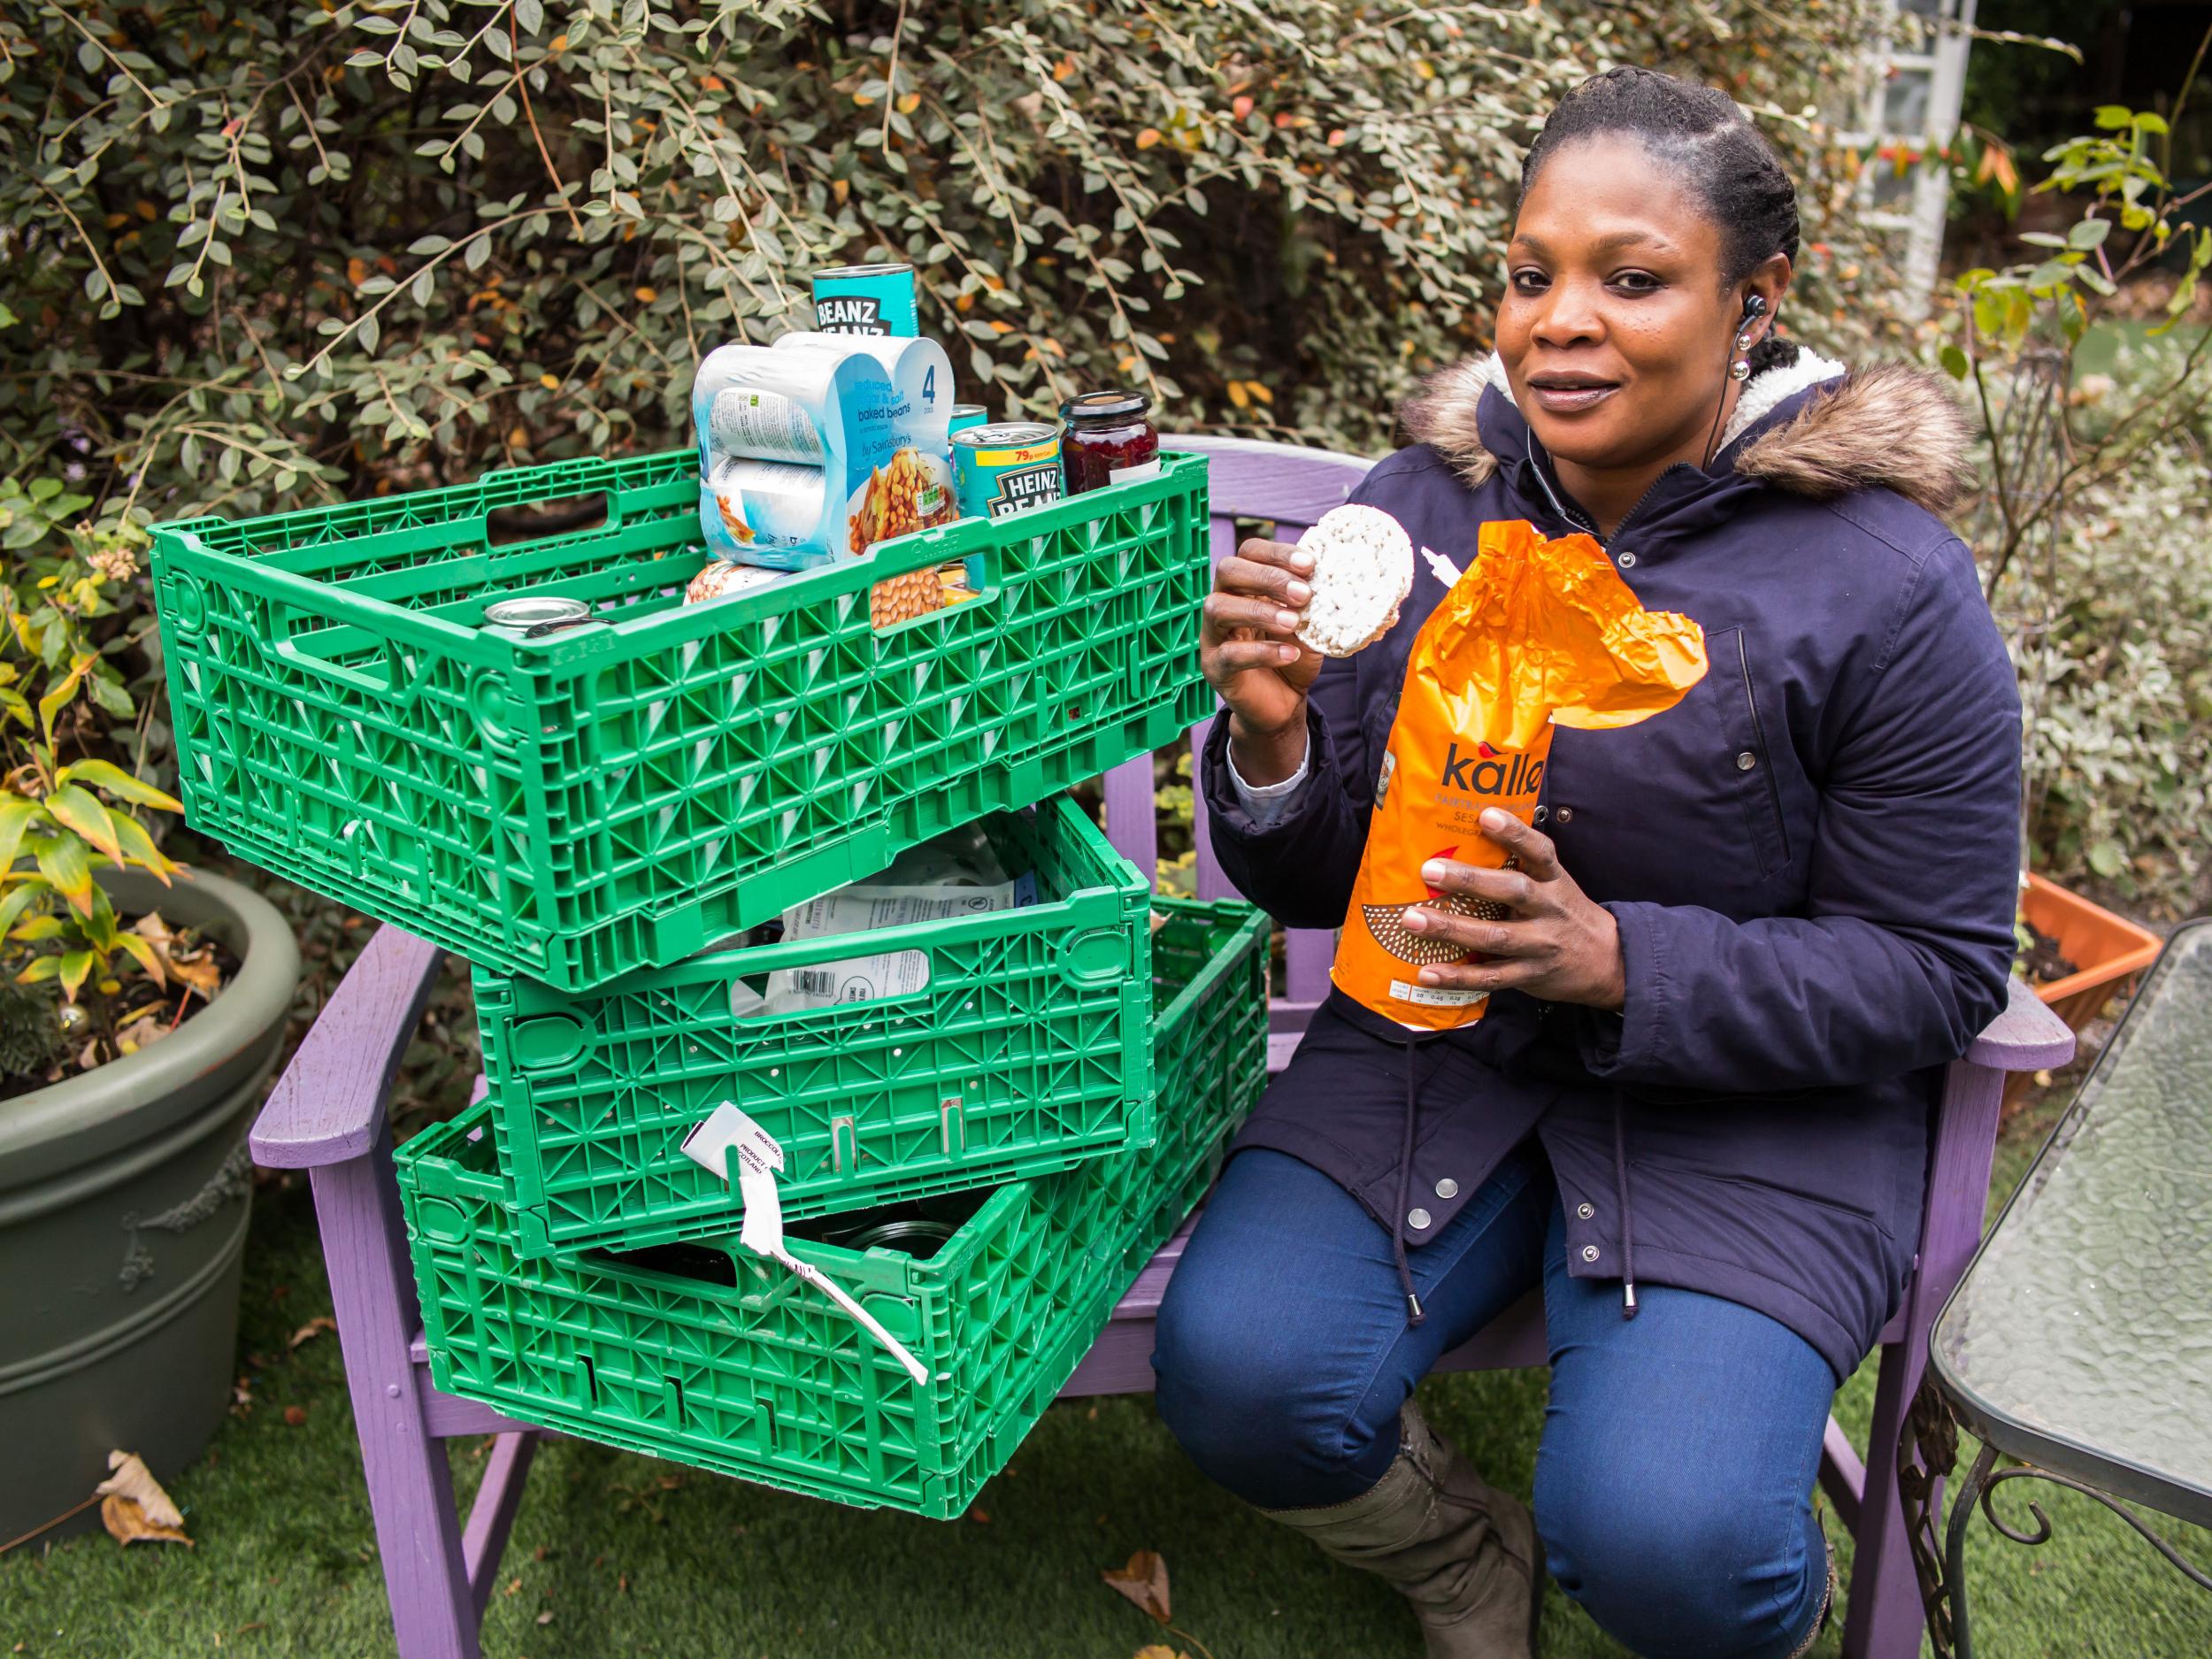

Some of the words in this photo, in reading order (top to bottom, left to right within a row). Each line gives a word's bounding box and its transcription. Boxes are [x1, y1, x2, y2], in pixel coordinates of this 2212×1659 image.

[818, 301, 876, 326] BEANZ
[922, 365, 935, 403] 4
[857, 406, 885, 421] baked
[887, 403, 910, 418] beans
[872, 433, 911, 454] Sainsbury's
[1015, 450, 1033, 461] 79p
[1007, 470, 1056, 497] HEINZ
[738, 1151, 762, 1174] COTLAND
[740, 1143, 765, 1166] PRODUCT
